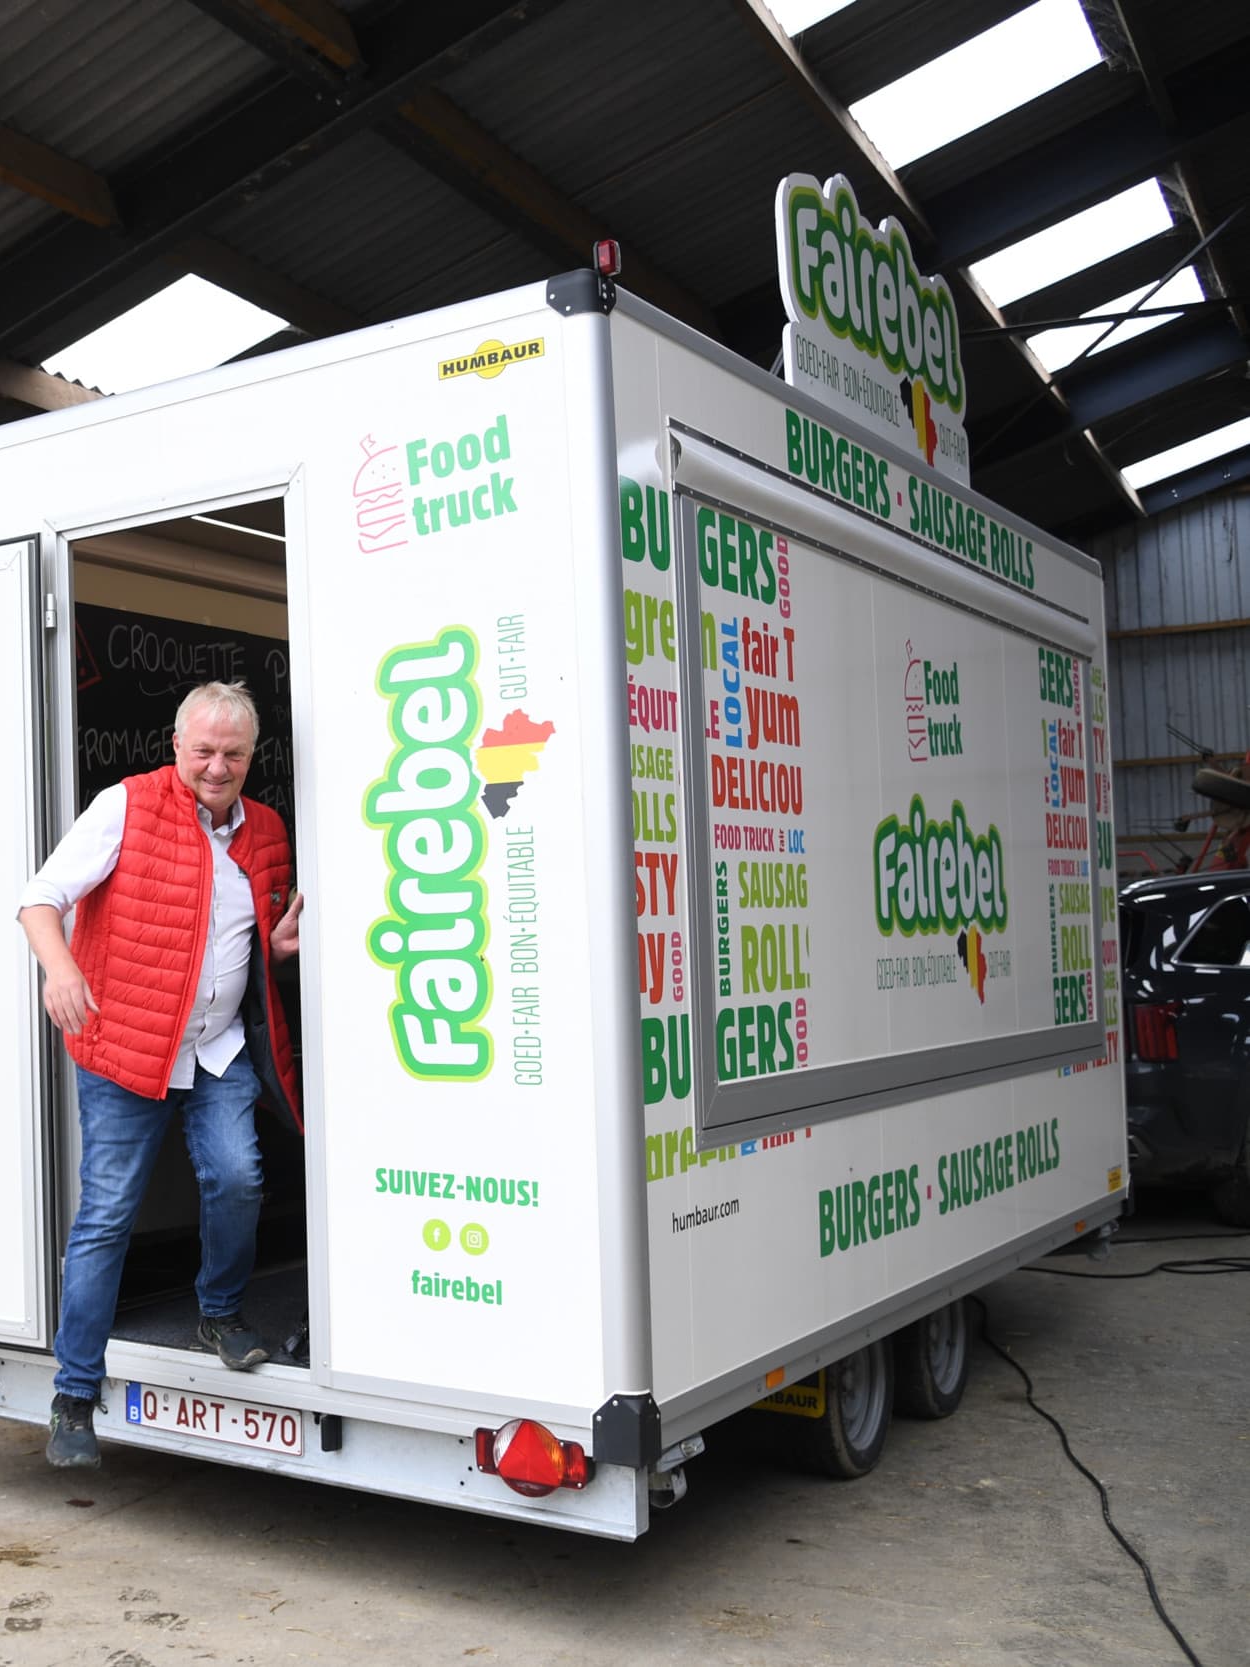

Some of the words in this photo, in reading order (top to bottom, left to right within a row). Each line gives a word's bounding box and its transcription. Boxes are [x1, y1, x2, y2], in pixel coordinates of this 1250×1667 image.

[791, 194, 962, 408] Fairebel
[442, 341, 540, 376] HUMBAUR
[406, 414, 510, 485] Food
[412, 472, 518, 535] truck
[786, 408, 890, 519] BURGERS
[908, 475, 987, 567] SAUSAGE
[989, 518, 1035, 590] ROLLS
[777, 536, 791, 619] GOOD
[108, 624, 247, 681] CROQUETTE
[742, 616, 778, 678] fair
[721, 617, 742, 748] LOCAL
[923, 660, 959, 705] Food
[745, 687, 800, 750] yum
[928, 714, 963, 757] truck
[1058, 717, 1075, 758] fair
[364, 628, 491, 1077] Fairebel
[714, 824, 741, 850] FOOD
[743, 826, 775, 852] TRUCK
[876, 799, 1006, 932] Fairebel
[715, 861, 731, 997] BURGERS
[671, 931, 683, 1002] GOOD
[375, 1168, 539, 1207] SUIVEZ-NOUS!
[672, 1199, 740, 1233] humbaur.com
[818, 1164, 920, 1258] BURGERS
[938, 1134, 1014, 1215] SAUSAGE
[1016, 1117, 1060, 1184] ROLLS
[412, 1269, 502, 1306] fairebel
[130, 1405, 140, 1420] B
[143, 1391, 296, 1447] Q-ART-570
